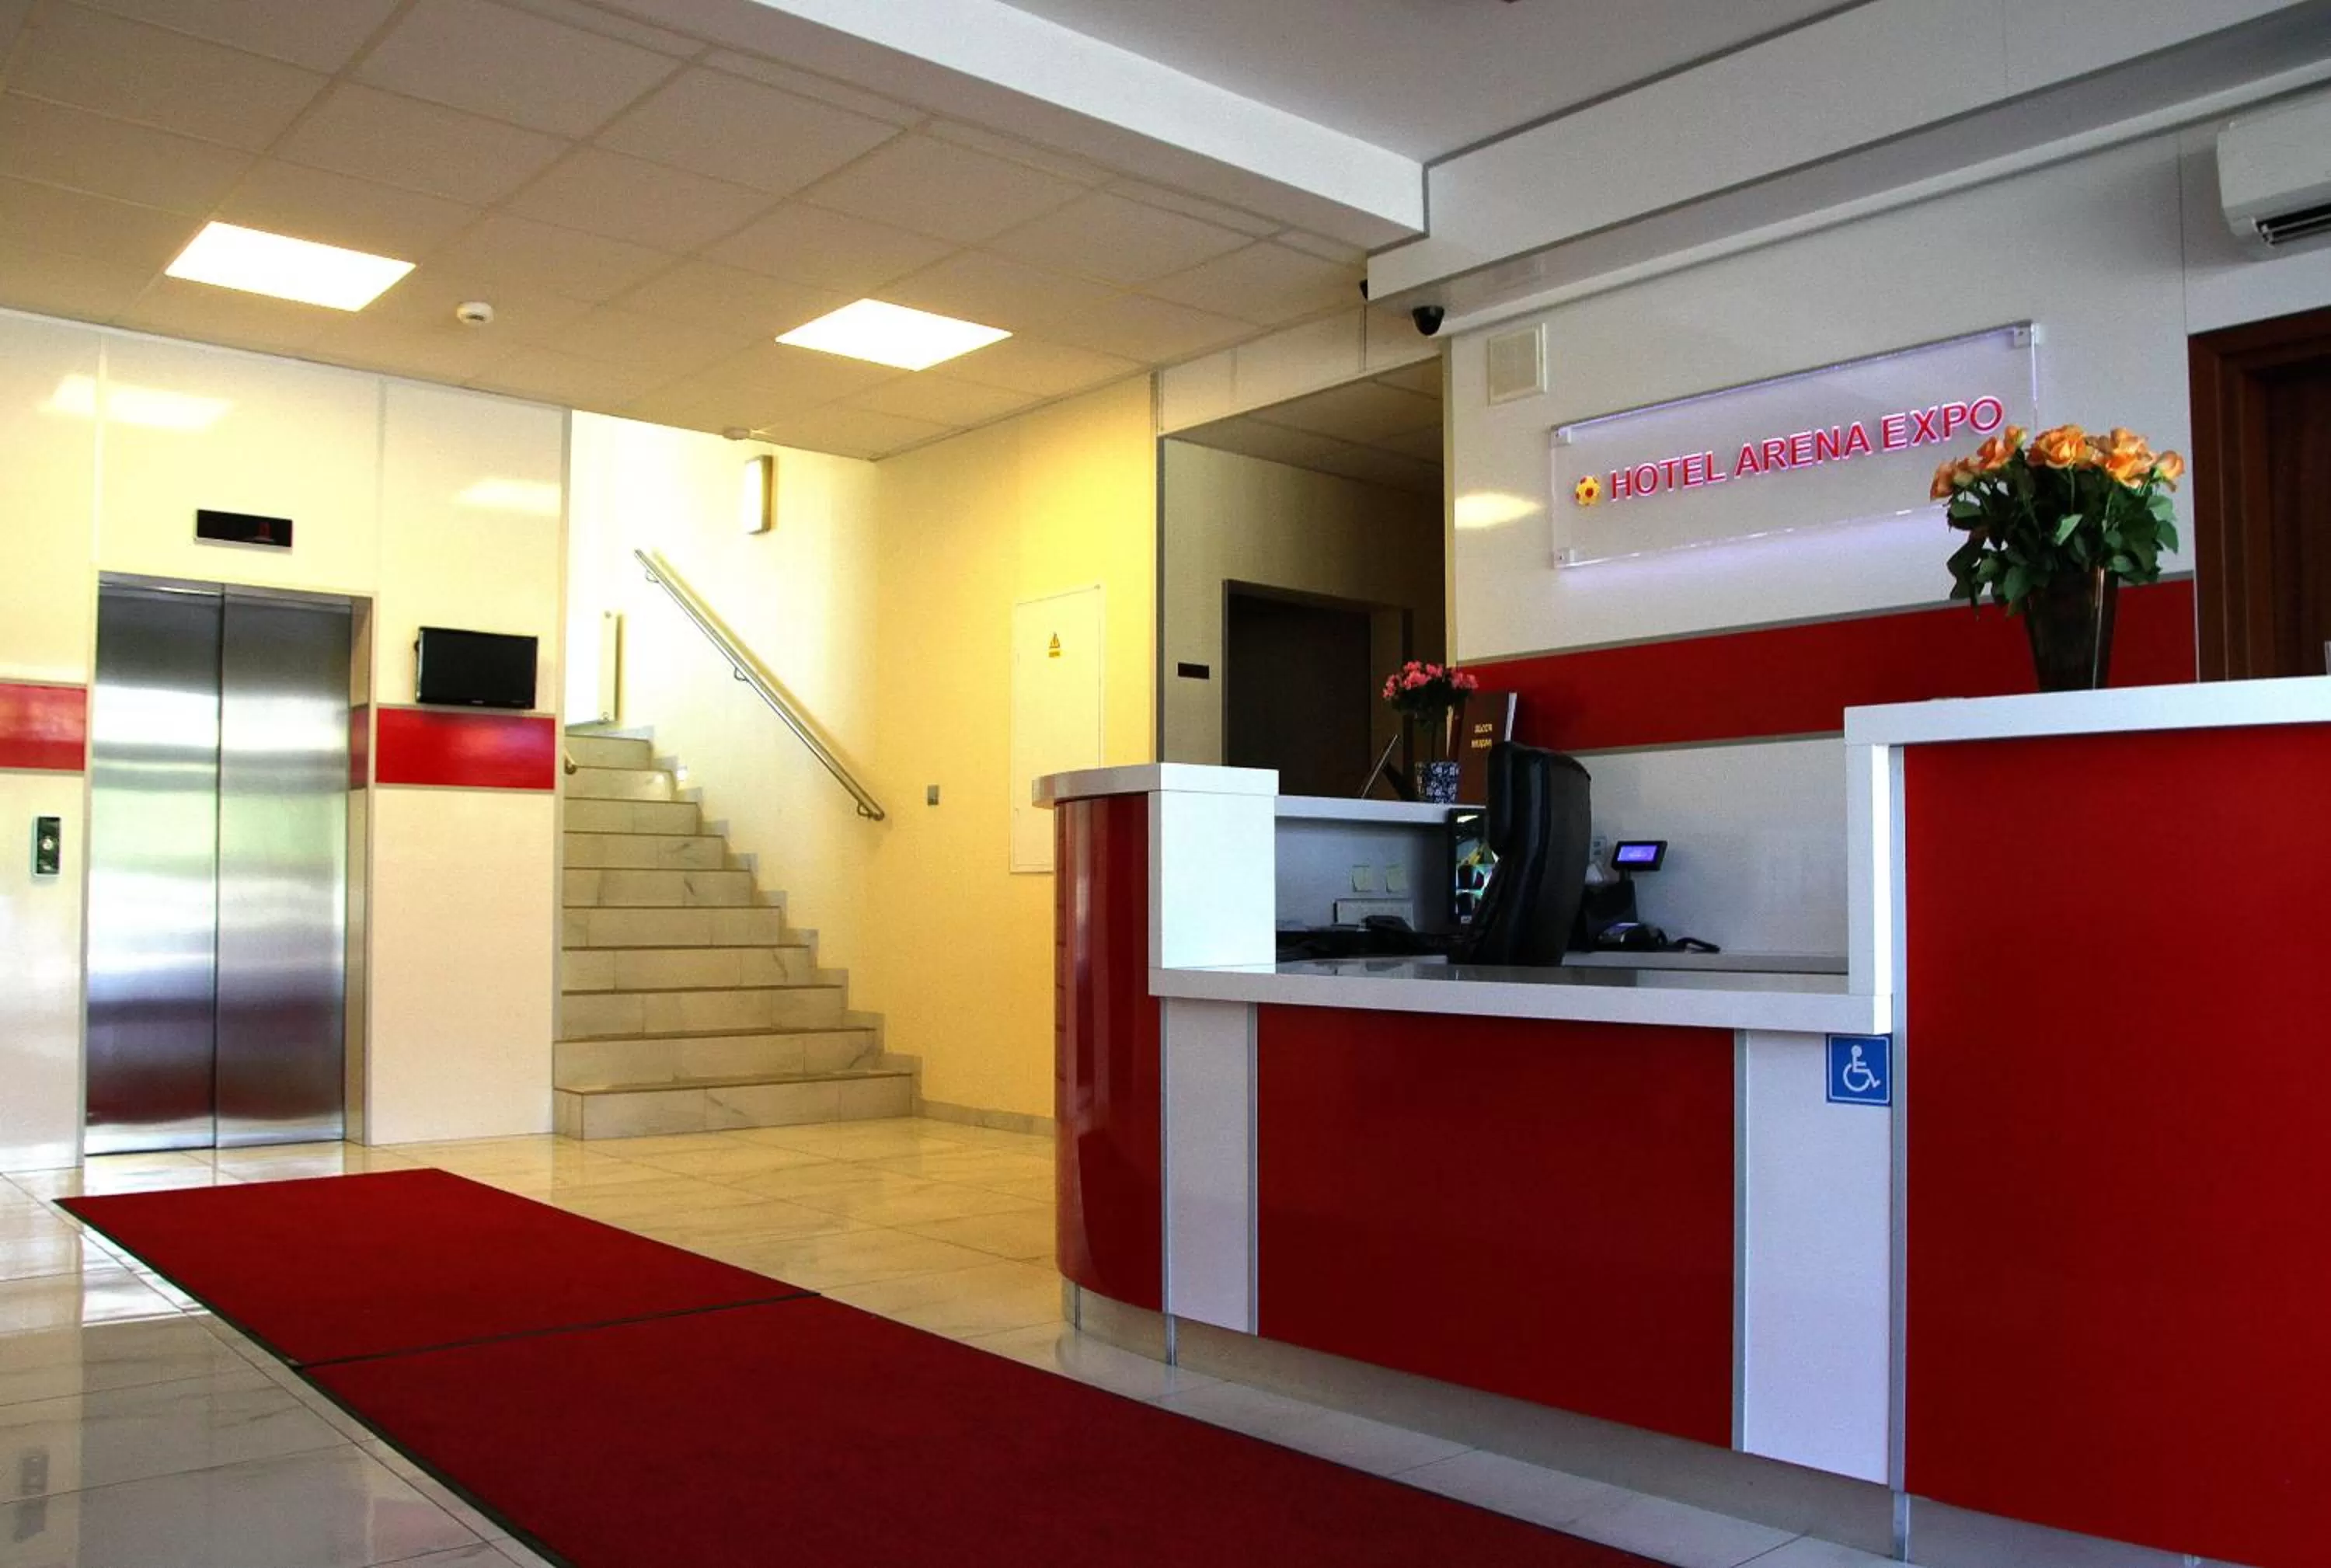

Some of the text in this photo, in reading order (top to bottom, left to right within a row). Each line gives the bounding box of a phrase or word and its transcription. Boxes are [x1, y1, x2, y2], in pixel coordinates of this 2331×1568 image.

[1611, 395, 2004, 501] HOTEL ARENA EXPO
